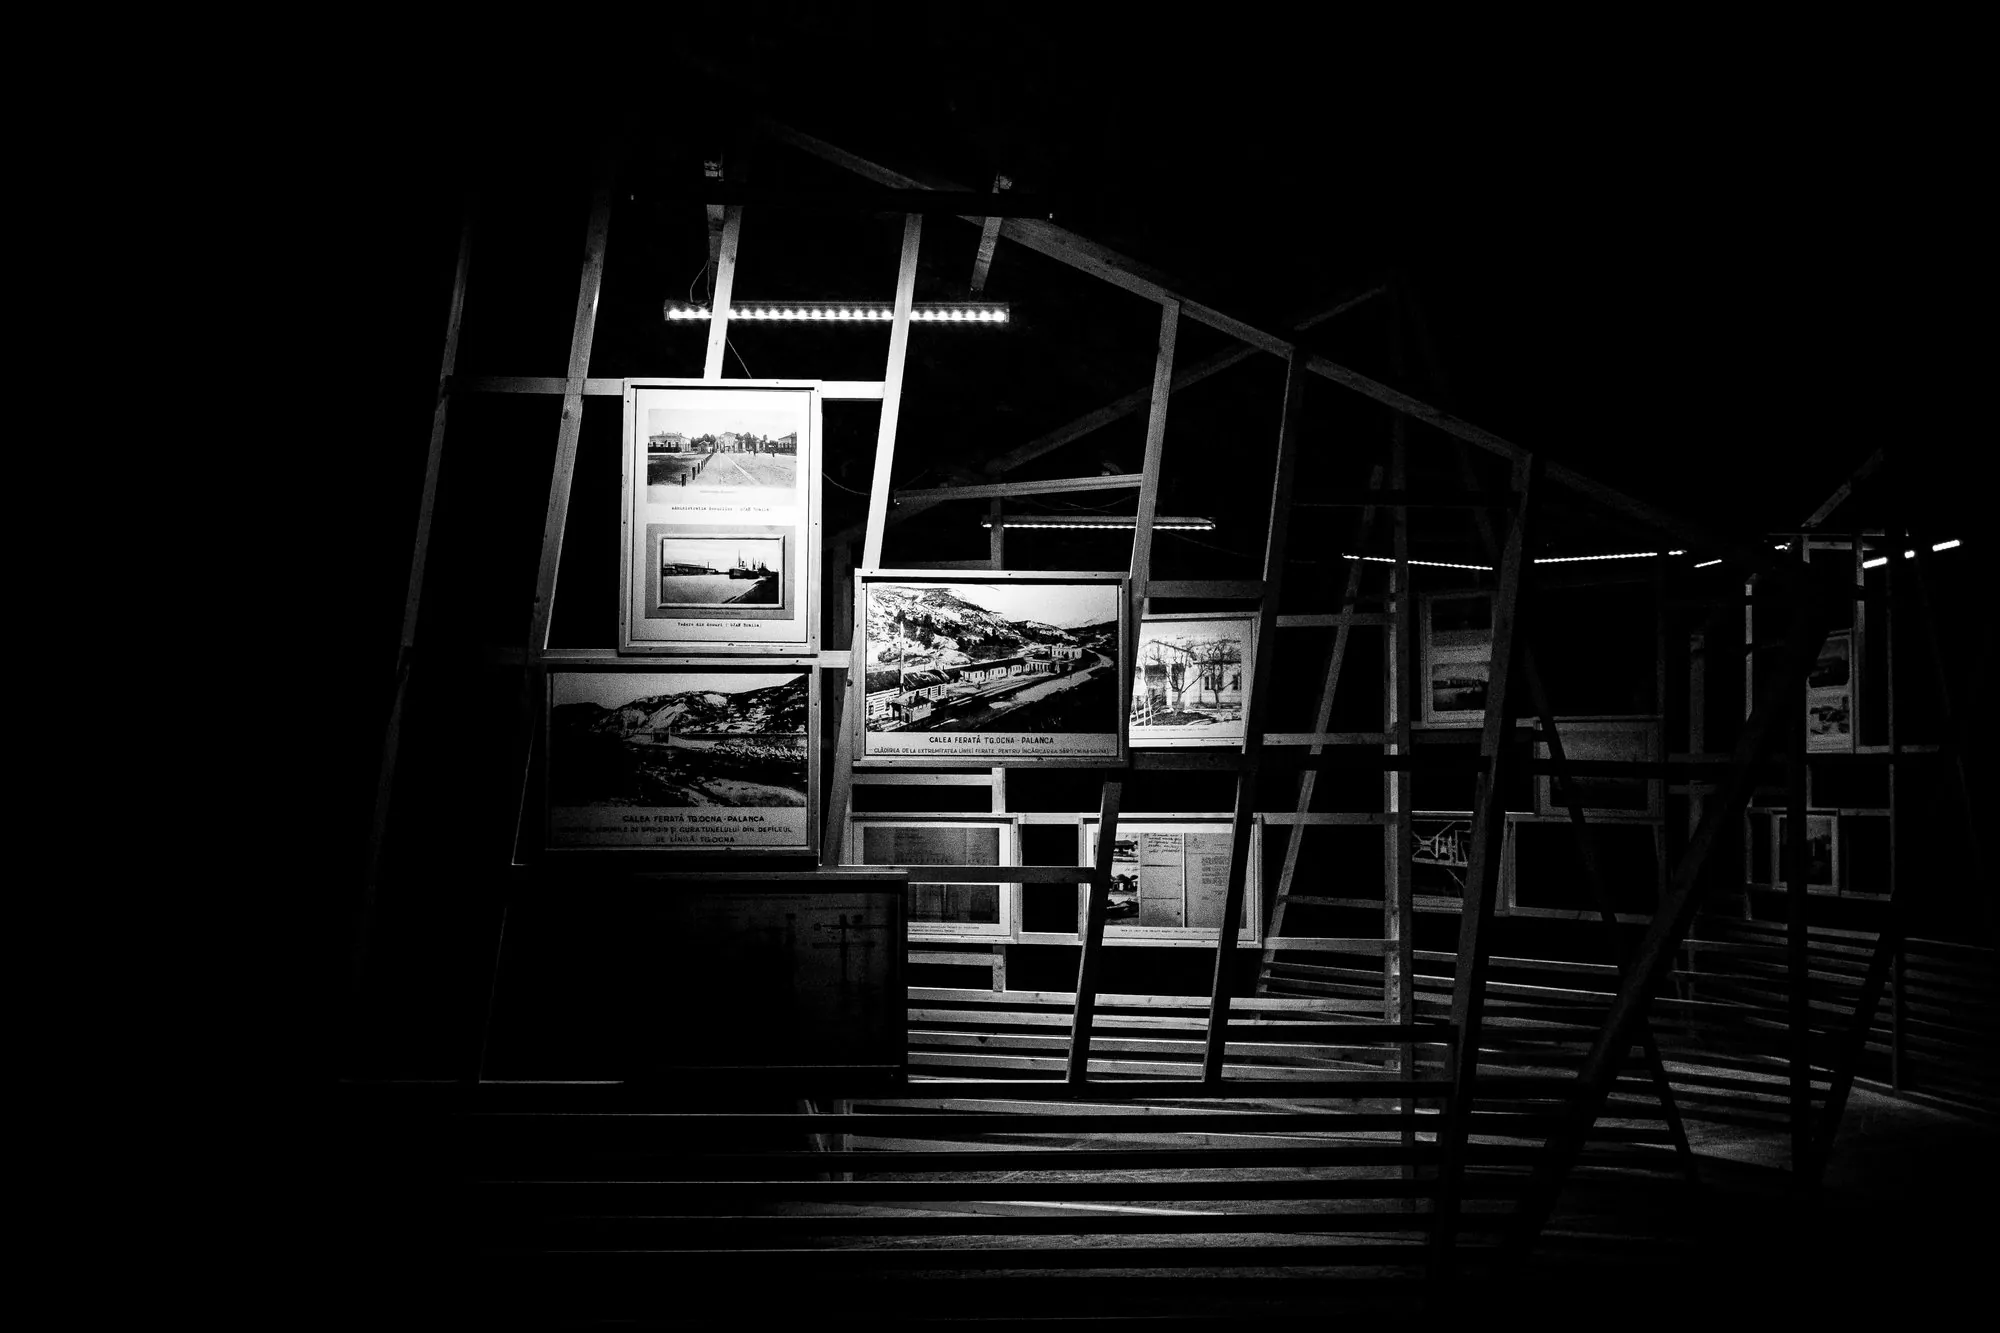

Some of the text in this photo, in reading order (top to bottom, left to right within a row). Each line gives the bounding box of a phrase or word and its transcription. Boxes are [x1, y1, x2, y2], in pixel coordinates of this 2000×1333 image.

[954, 734, 981, 744] FERATĂ
[1021, 736, 1054, 744] PALANCA
[622, 815, 651, 823] CALEA
[653, 813, 685, 823] FERATĂ
[727, 815, 765, 823] PALANCA
